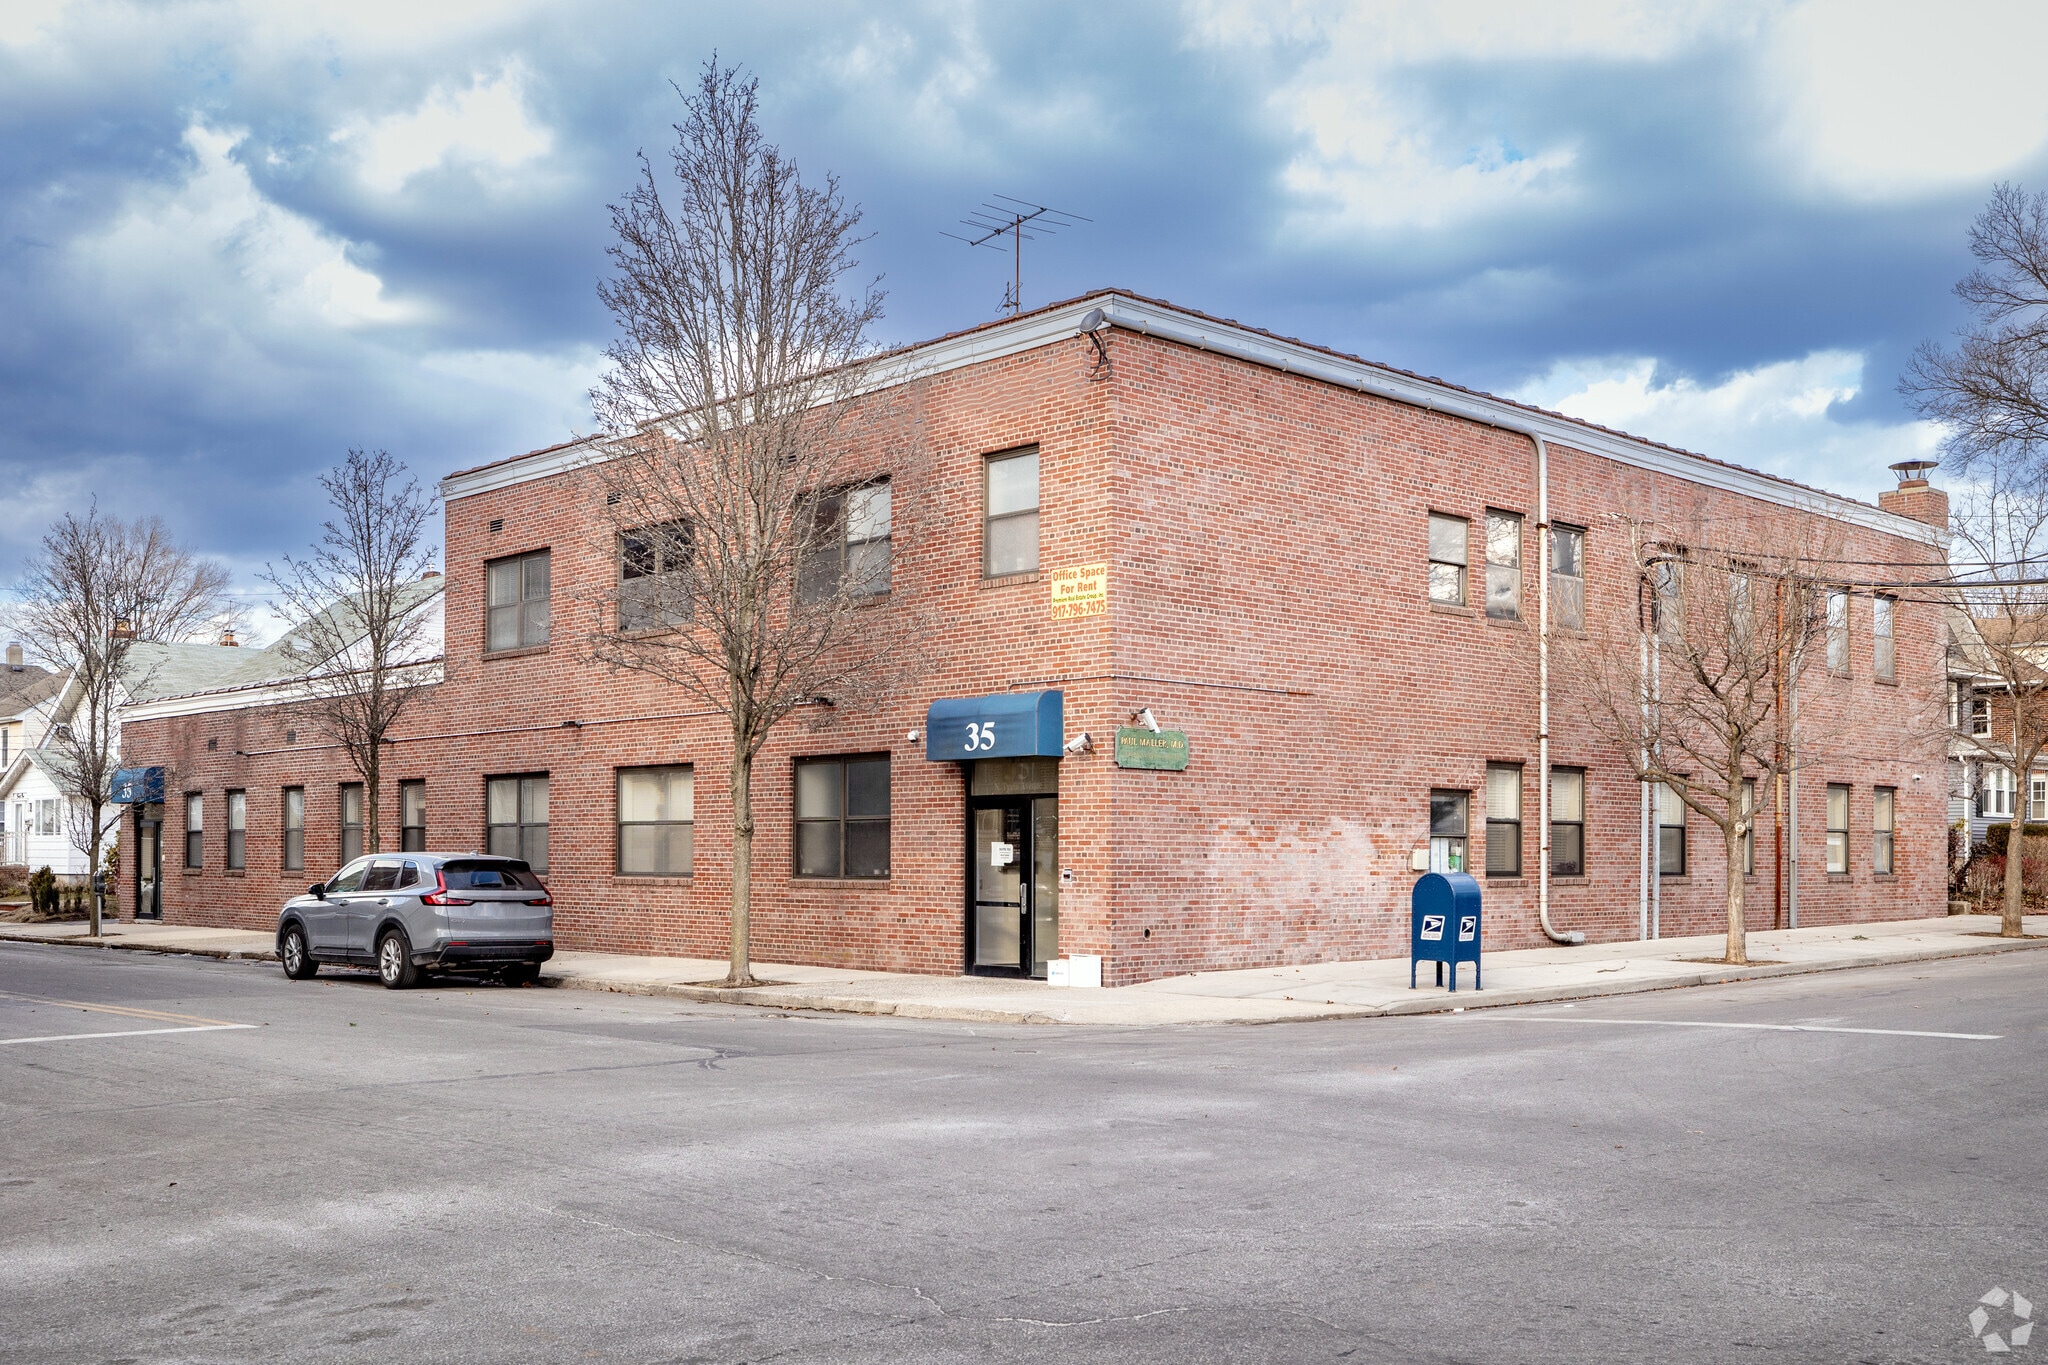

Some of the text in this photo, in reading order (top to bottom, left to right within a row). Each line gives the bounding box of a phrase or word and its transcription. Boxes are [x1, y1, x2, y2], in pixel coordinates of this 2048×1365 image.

[1053, 567, 1105, 581] Office Space
[1060, 580, 1097, 594] For Rent
[1052, 599, 1106, 618] 917-796-7475
[964, 721, 996, 752] 35
[1121, 736, 1137, 746] PAUL
[1170, 740, 1184, 749] M.D.
